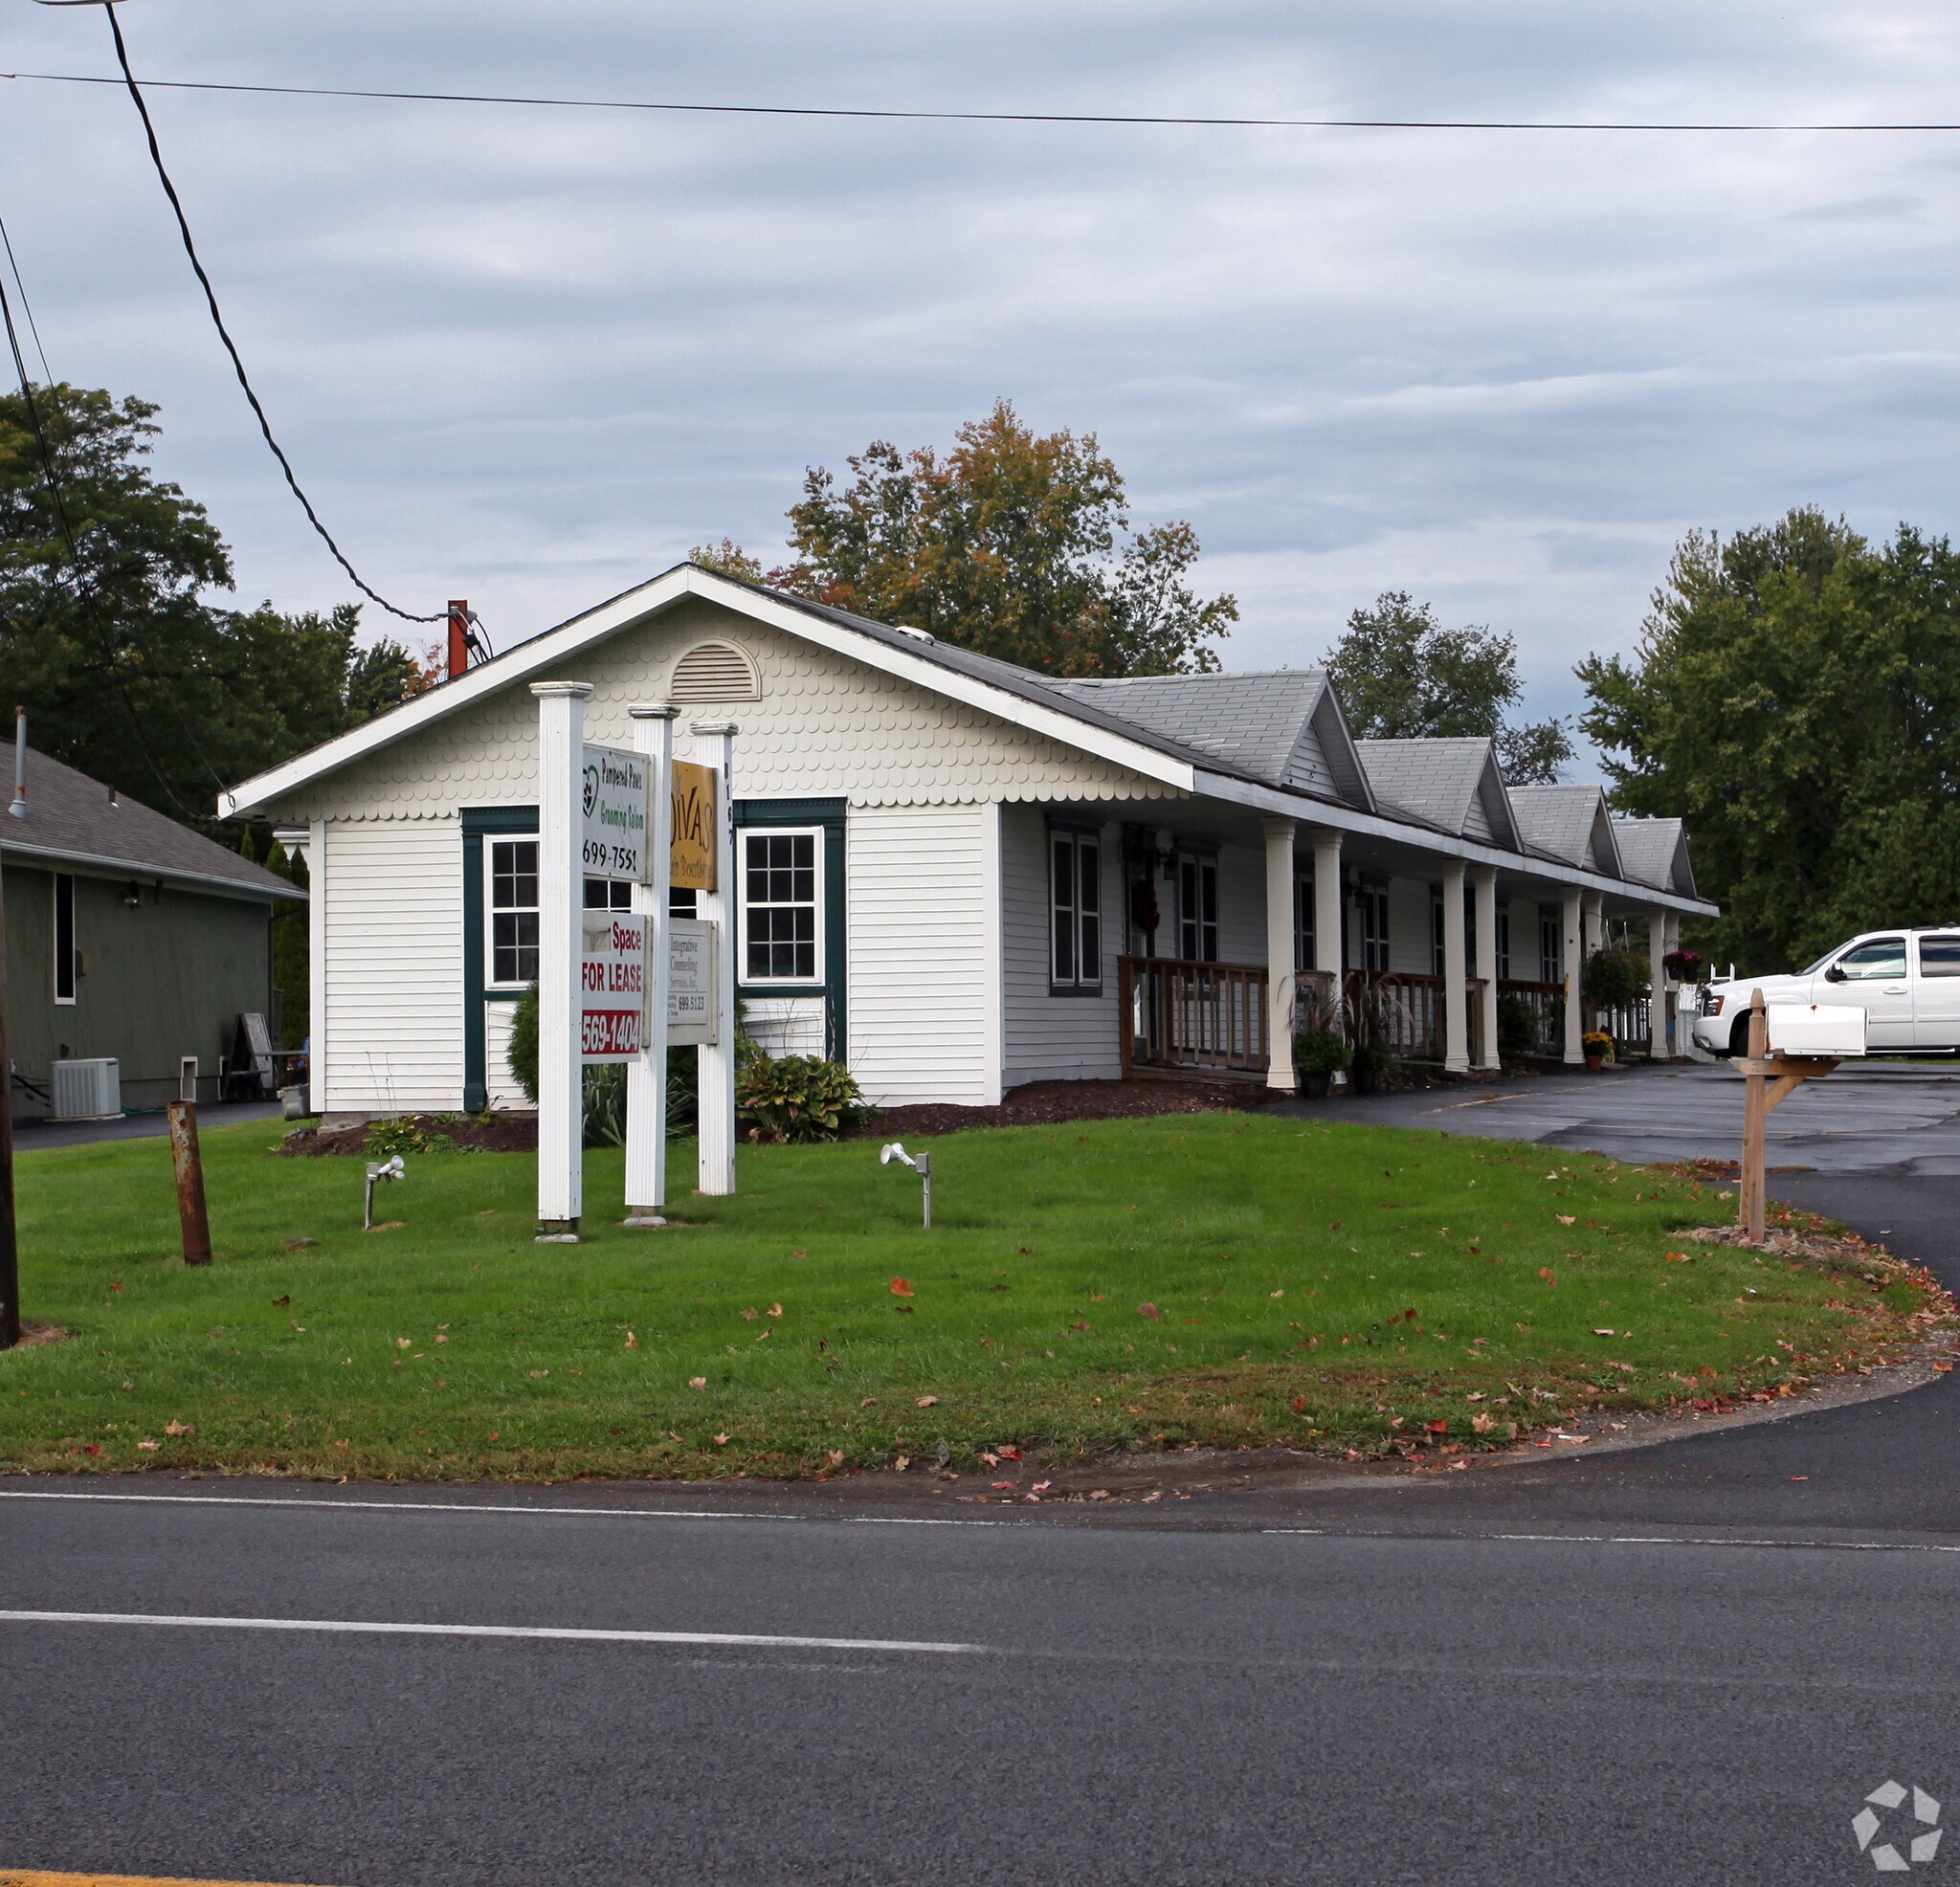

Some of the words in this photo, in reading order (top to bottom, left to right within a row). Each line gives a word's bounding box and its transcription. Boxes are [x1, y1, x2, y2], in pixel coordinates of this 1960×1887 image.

[602, 757, 628, 791] Pampered
[629, 763, 642, 790] Paws
[601, 799, 628, 834] Grooming
[628, 804, 644, 830] Salon
[583, 838, 636, 872] 699-7551
[612, 921, 642, 957] Space
[670, 936, 698, 957] Integrative
[582, 962, 605, 992] FOR
[609, 963, 642, 993] LEASE
[670, 955, 698, 977] Counseling
[582, 1014, 639, 1052] 569-1404
